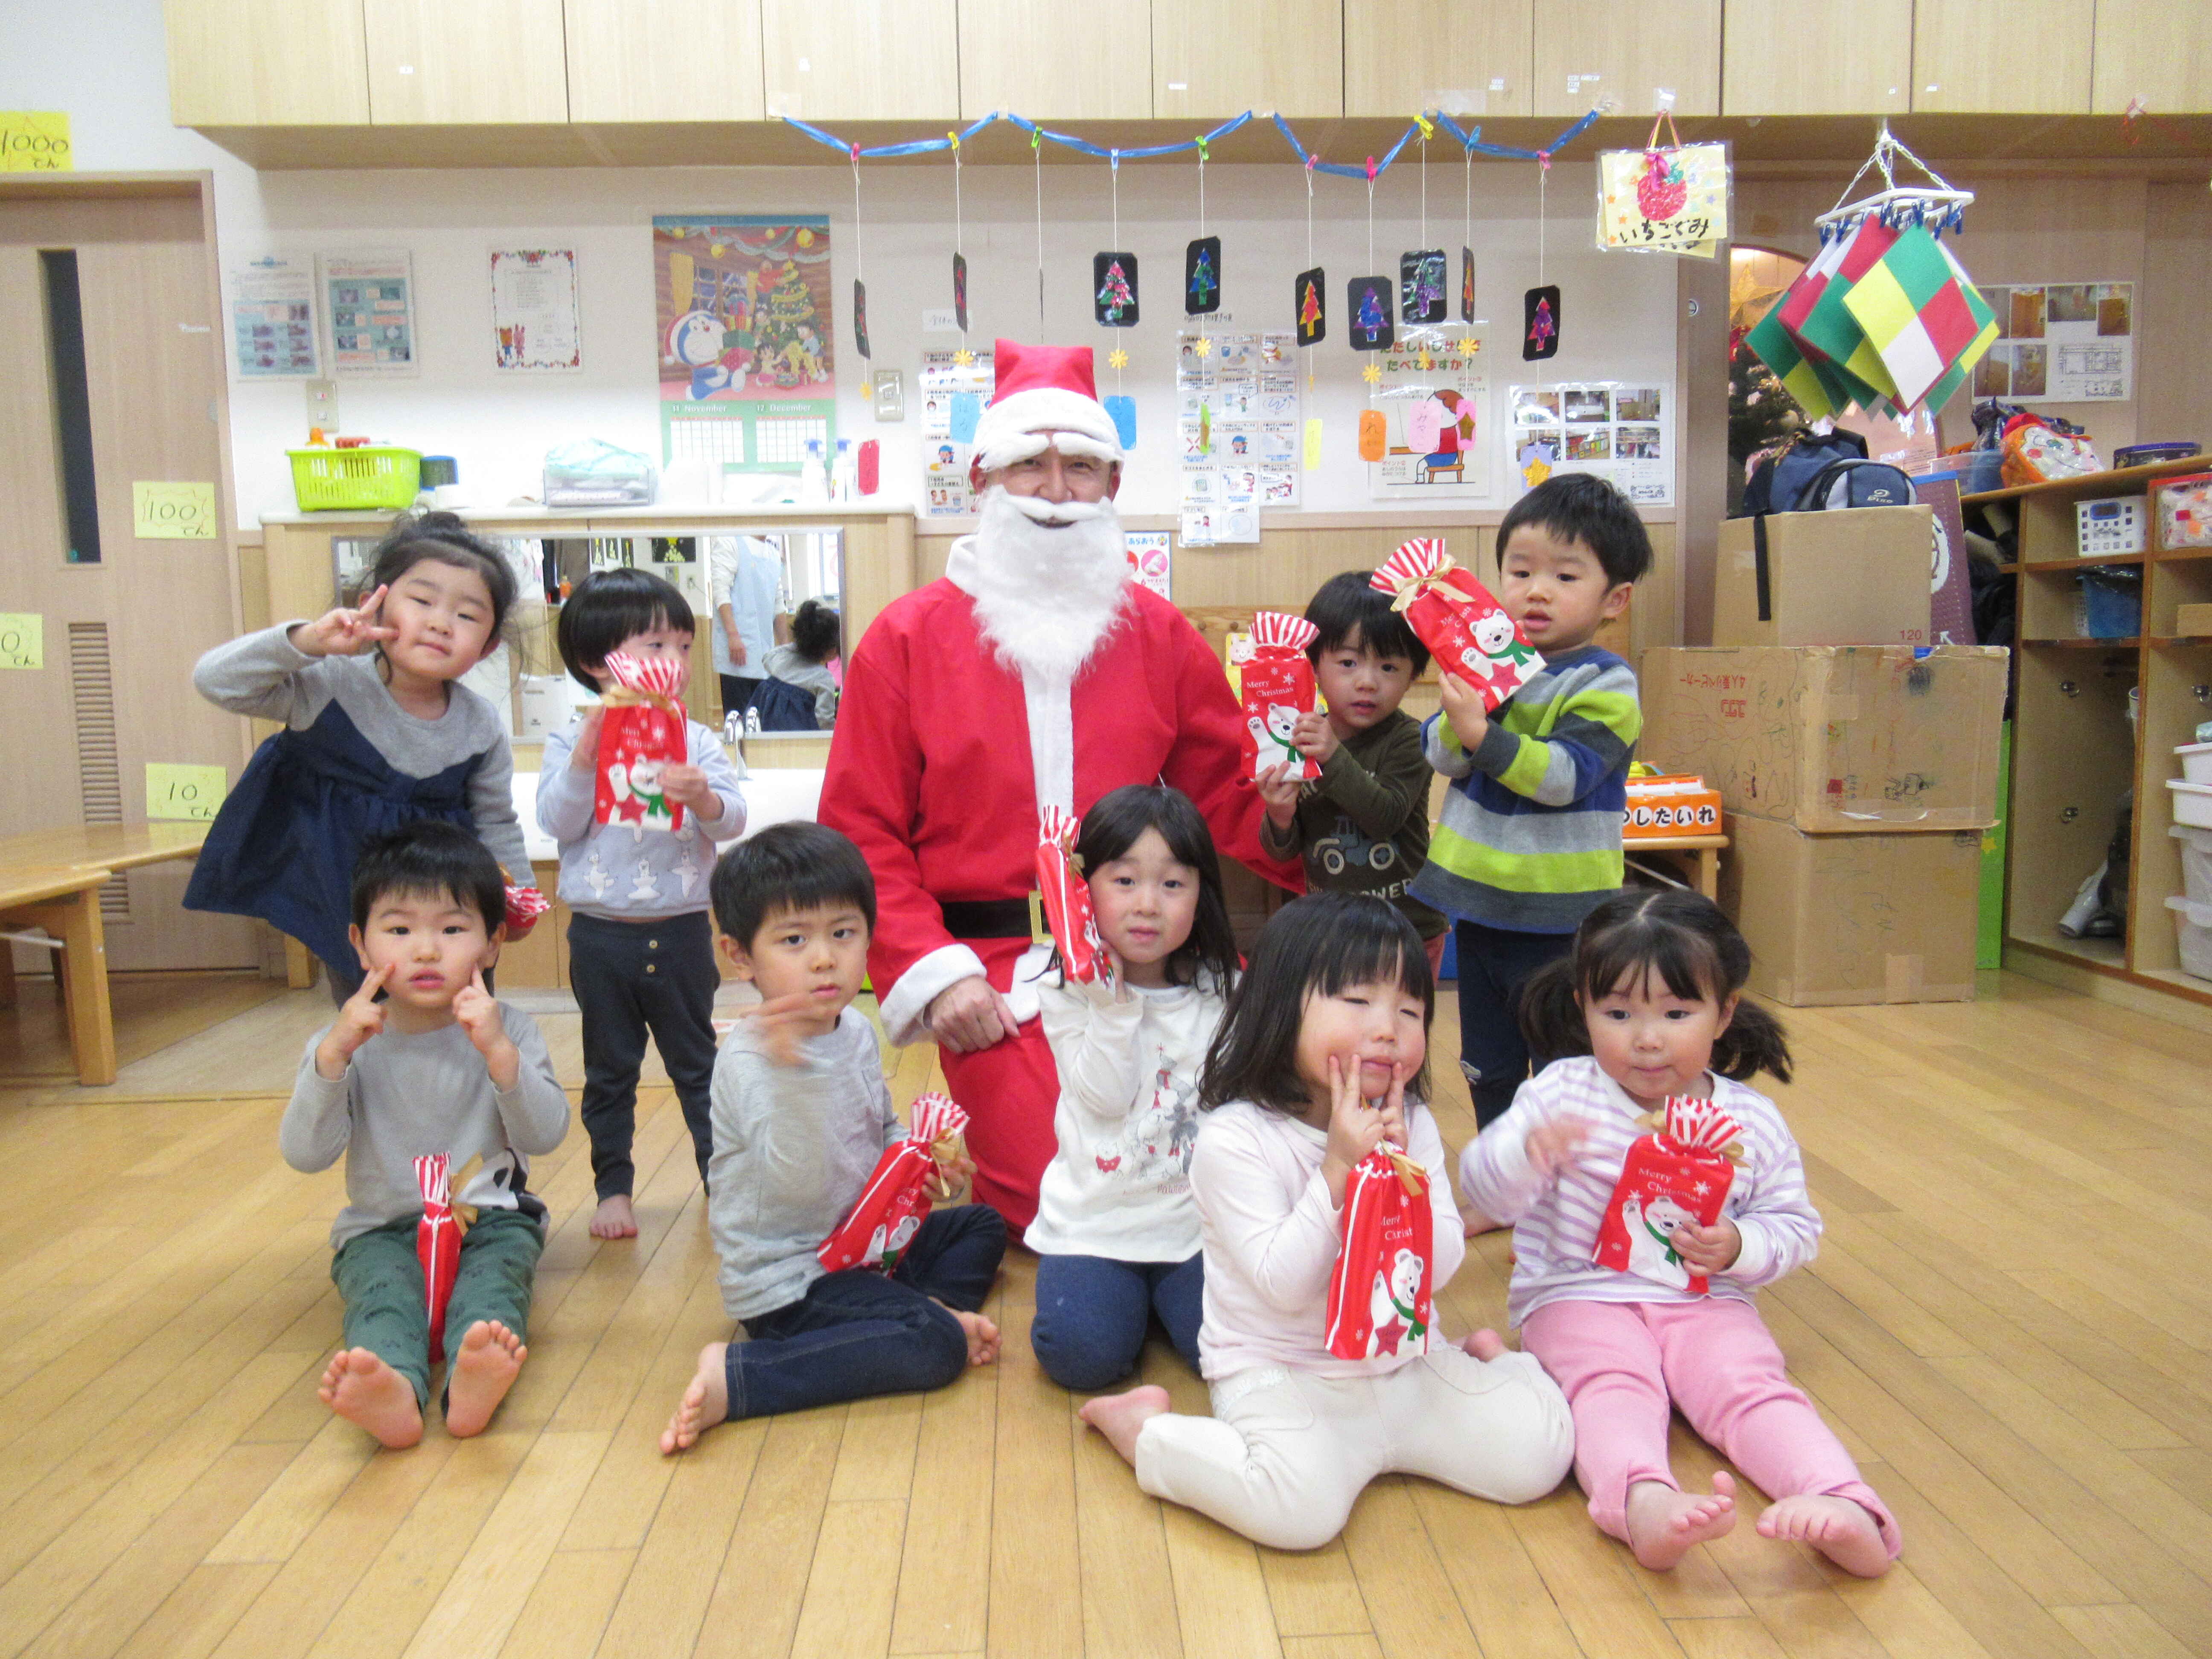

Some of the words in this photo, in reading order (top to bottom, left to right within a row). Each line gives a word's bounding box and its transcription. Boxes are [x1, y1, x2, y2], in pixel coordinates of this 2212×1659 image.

[1619, 218, 1708, 243] いちごぐみ
[150, 501, 197, 521] 100
[1900, 629, 1922, 640] 120
[1246, 680, 1269, 689] Merry
[1256, 687, 1294, 698] Christmas
[169, 782, 197, 800] 10
[1638, 1167, 1673, 1184] Merry
[1647, 1181, 1703, 1204] Christmas
